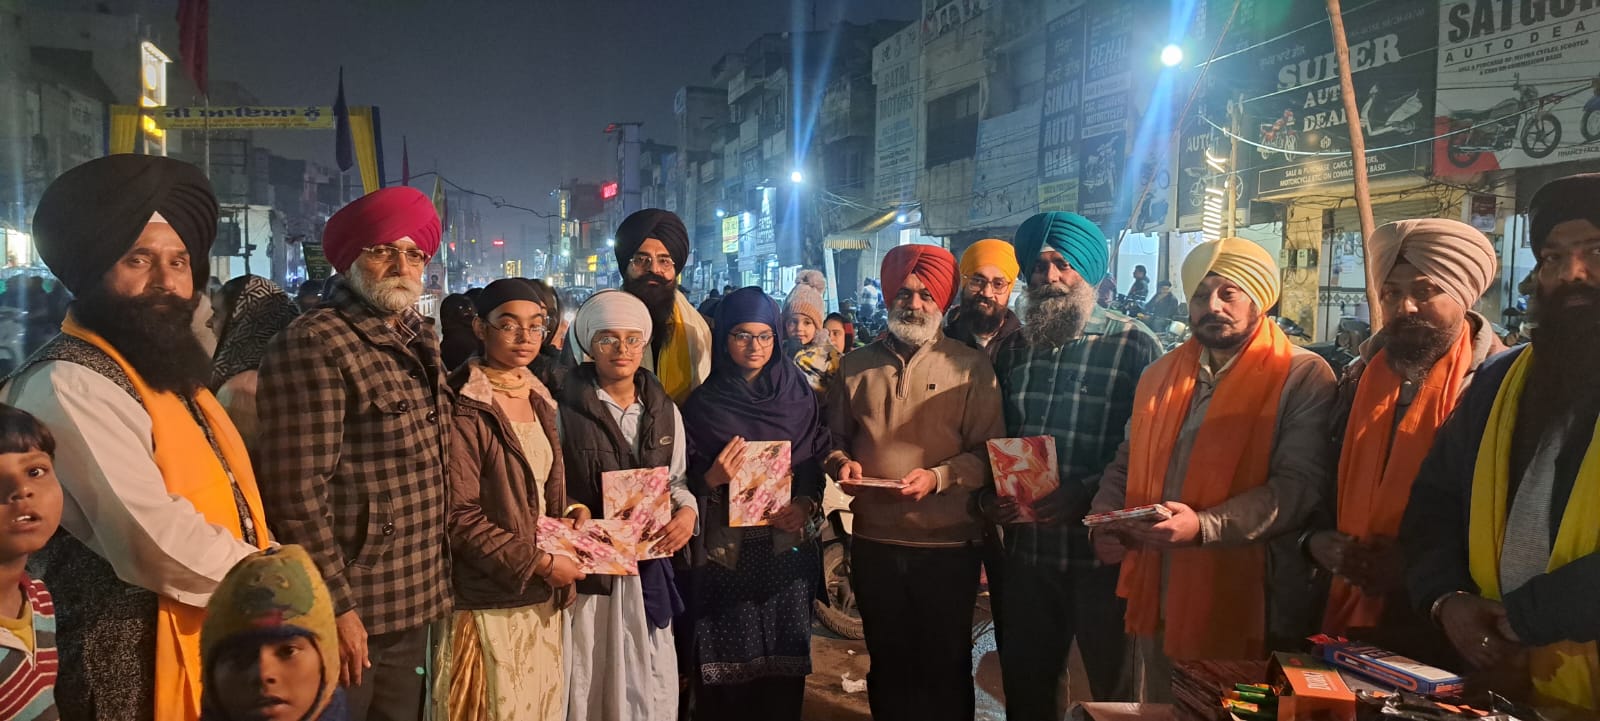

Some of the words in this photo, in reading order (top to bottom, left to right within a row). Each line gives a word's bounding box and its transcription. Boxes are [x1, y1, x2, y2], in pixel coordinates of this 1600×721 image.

[1448, 0, 1600, 43] SATG
[1446, 38, 1513, 63] AUTO
[1044, 79, 1080, 117] SIKKA
[1303, 84, 1341, 109] AUT
[1043, 112, 1076, 149] AUTO
[1044, 146, 1075, 178] DEAL
[1350, 155, 1379, 167] SERS,
